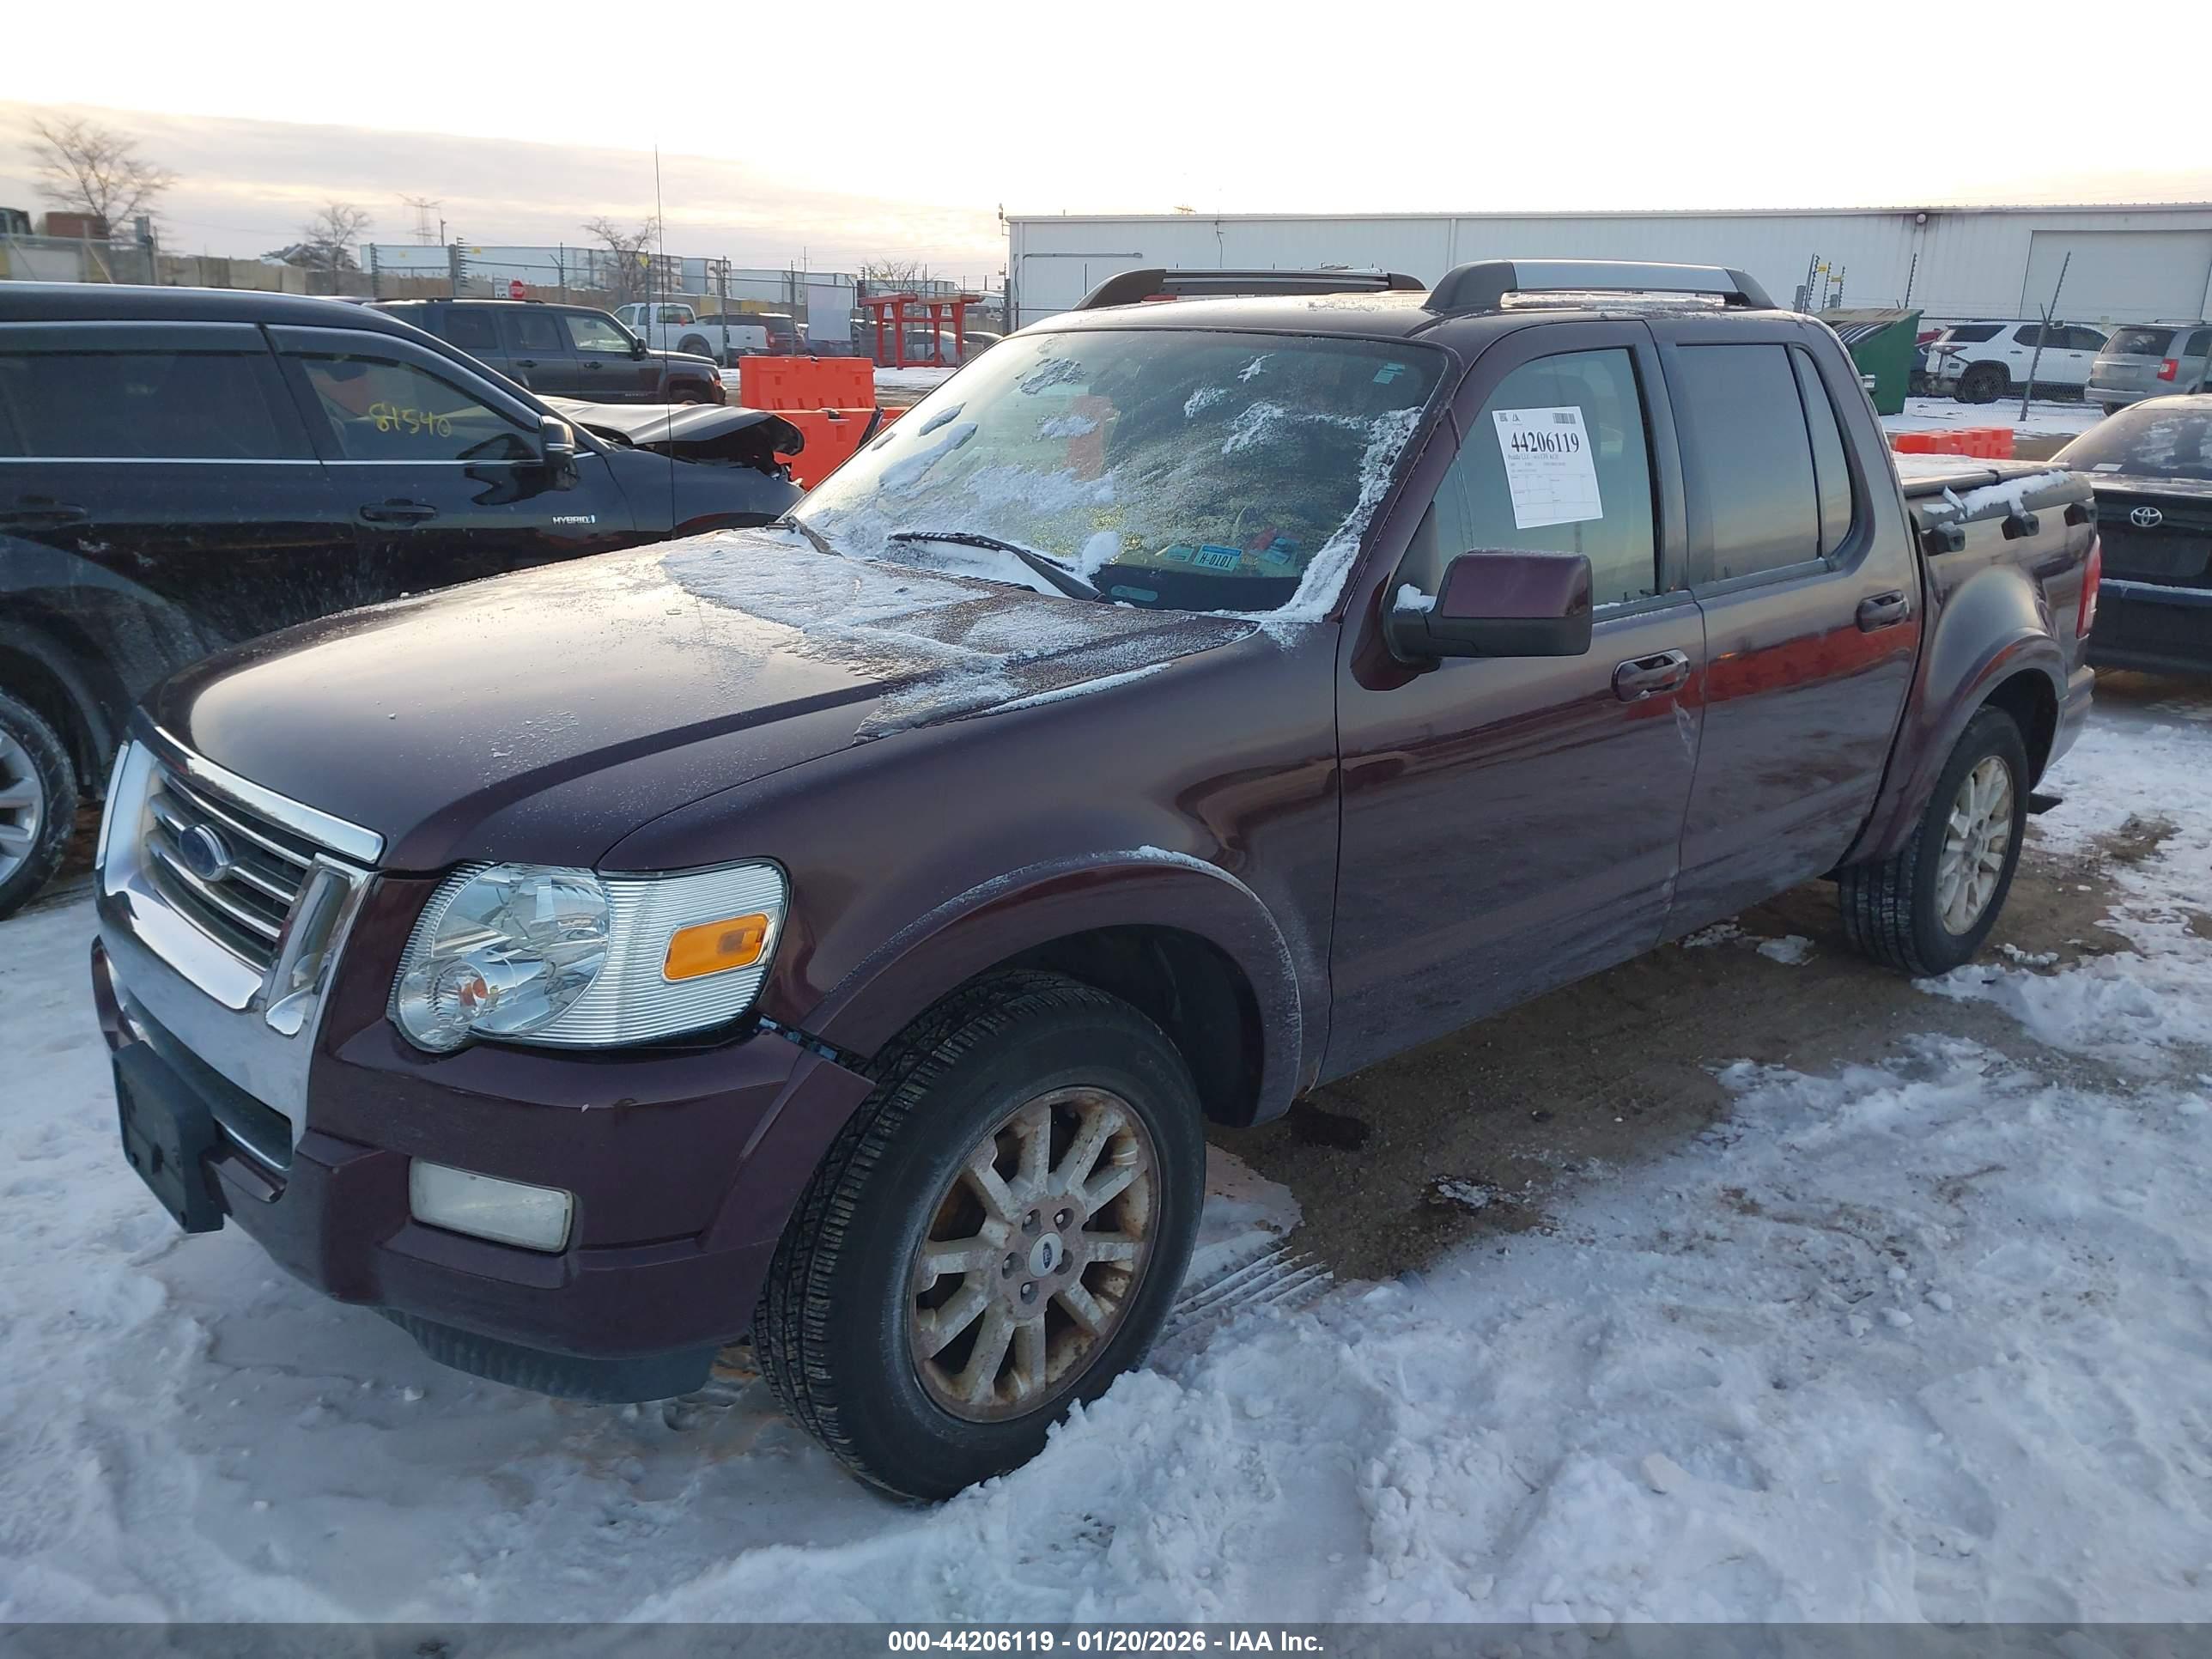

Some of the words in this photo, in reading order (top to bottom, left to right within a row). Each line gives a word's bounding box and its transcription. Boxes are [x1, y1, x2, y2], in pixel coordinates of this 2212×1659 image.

[369, 402, 452, 438] 81540
[1511, 432, 1579, 453] 44206119
[552, 515, 589, 525] HYBRID
